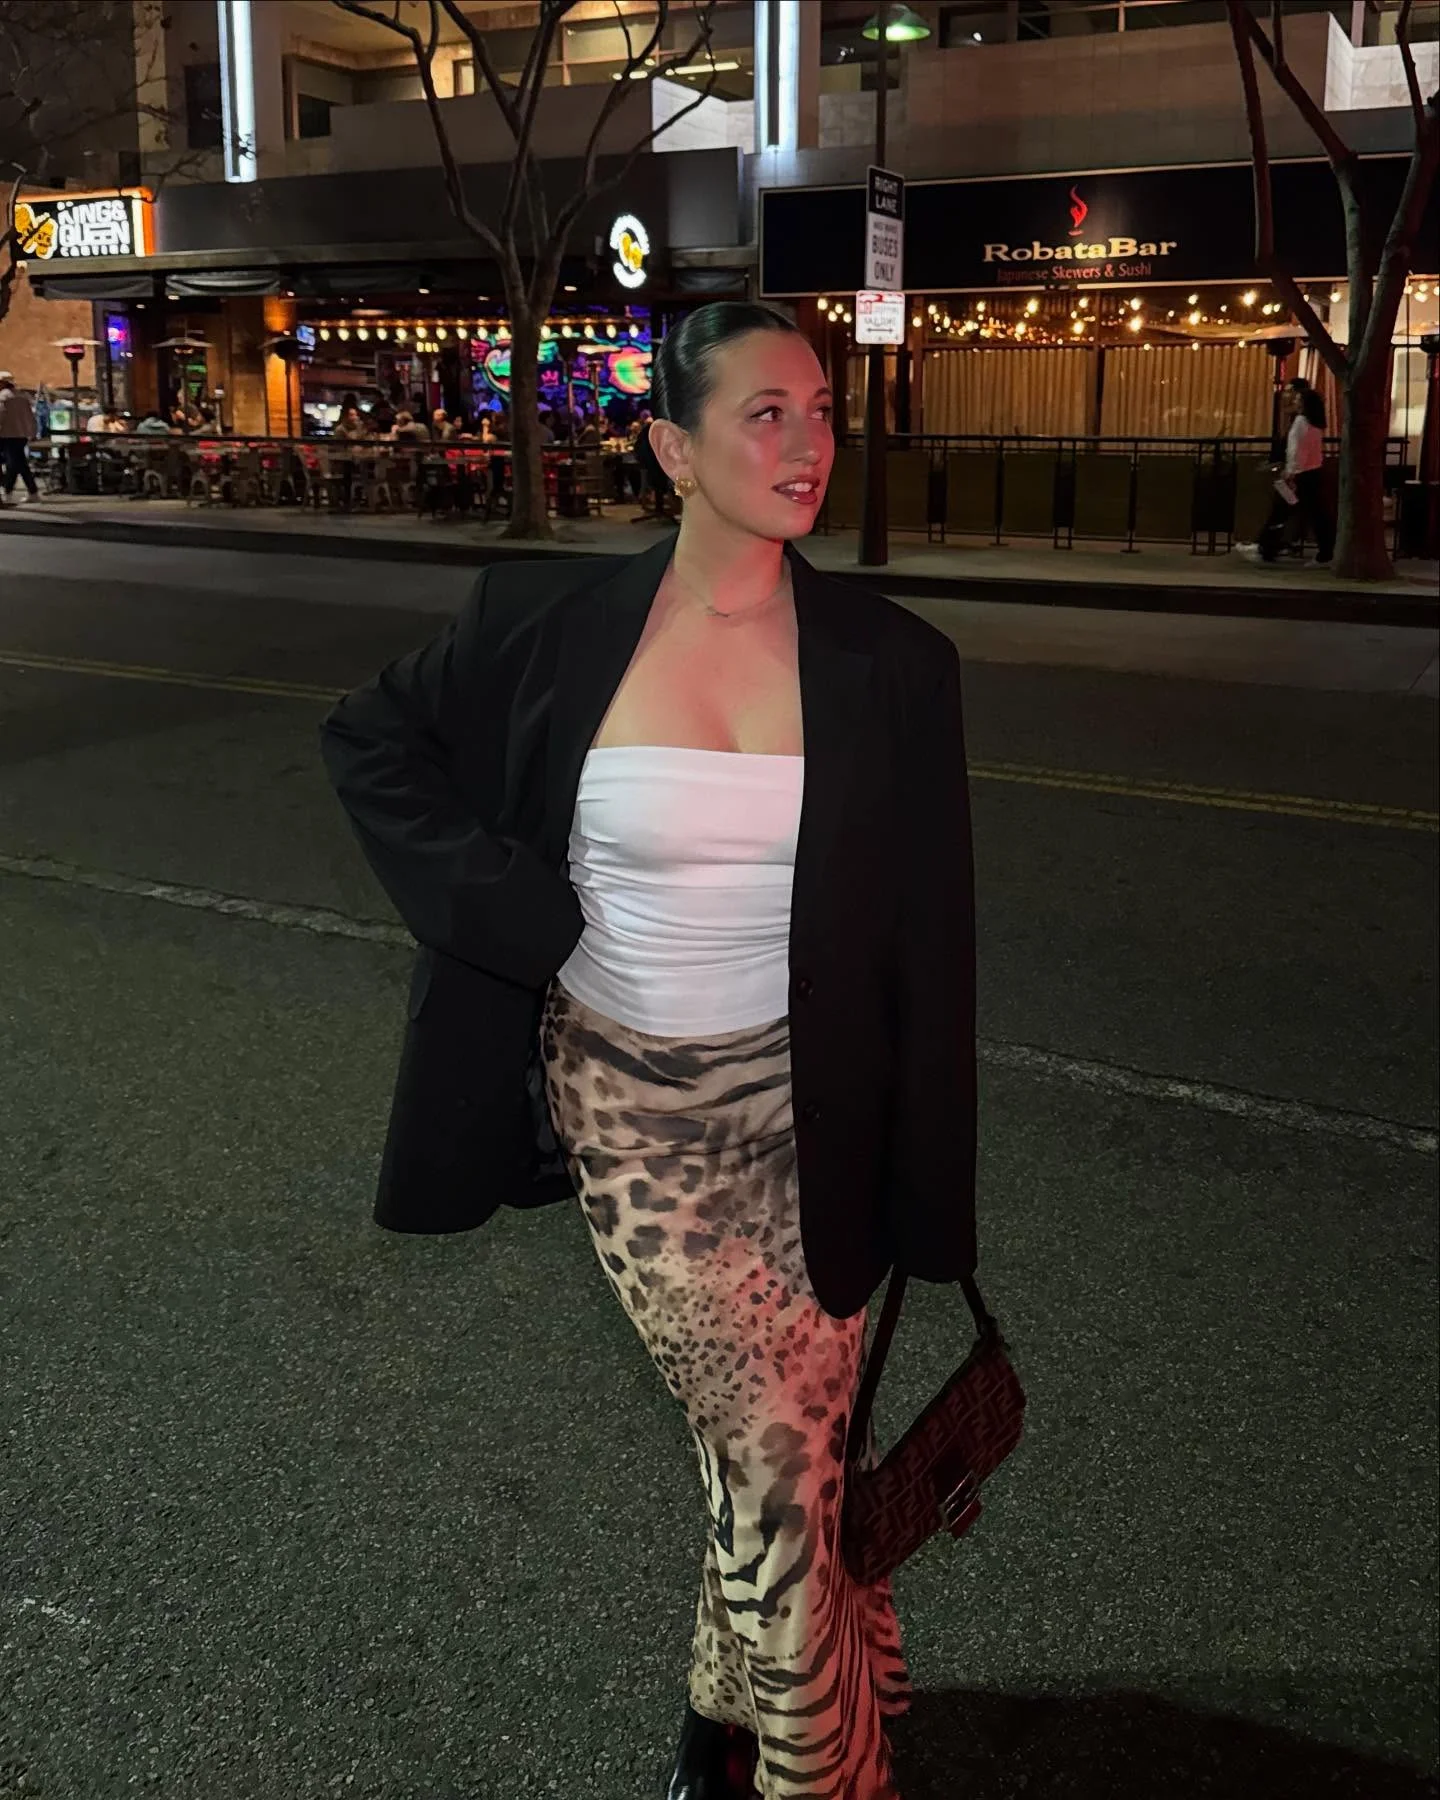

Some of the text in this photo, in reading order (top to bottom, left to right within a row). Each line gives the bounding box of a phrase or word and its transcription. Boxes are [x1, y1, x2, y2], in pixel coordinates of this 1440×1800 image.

[874, 176, 898, 195] RIGHT
[875, 193, 898, 213] LANE
[59, 220, 130, 247] QUEEN
[872, 235, 898, 258] BUSES
[982, 237, 1178, 262] RobataBar
[874, 261, 896, 281] ONLY
[997, 262, 1152, 284] Japanese Skewers & Sushi
